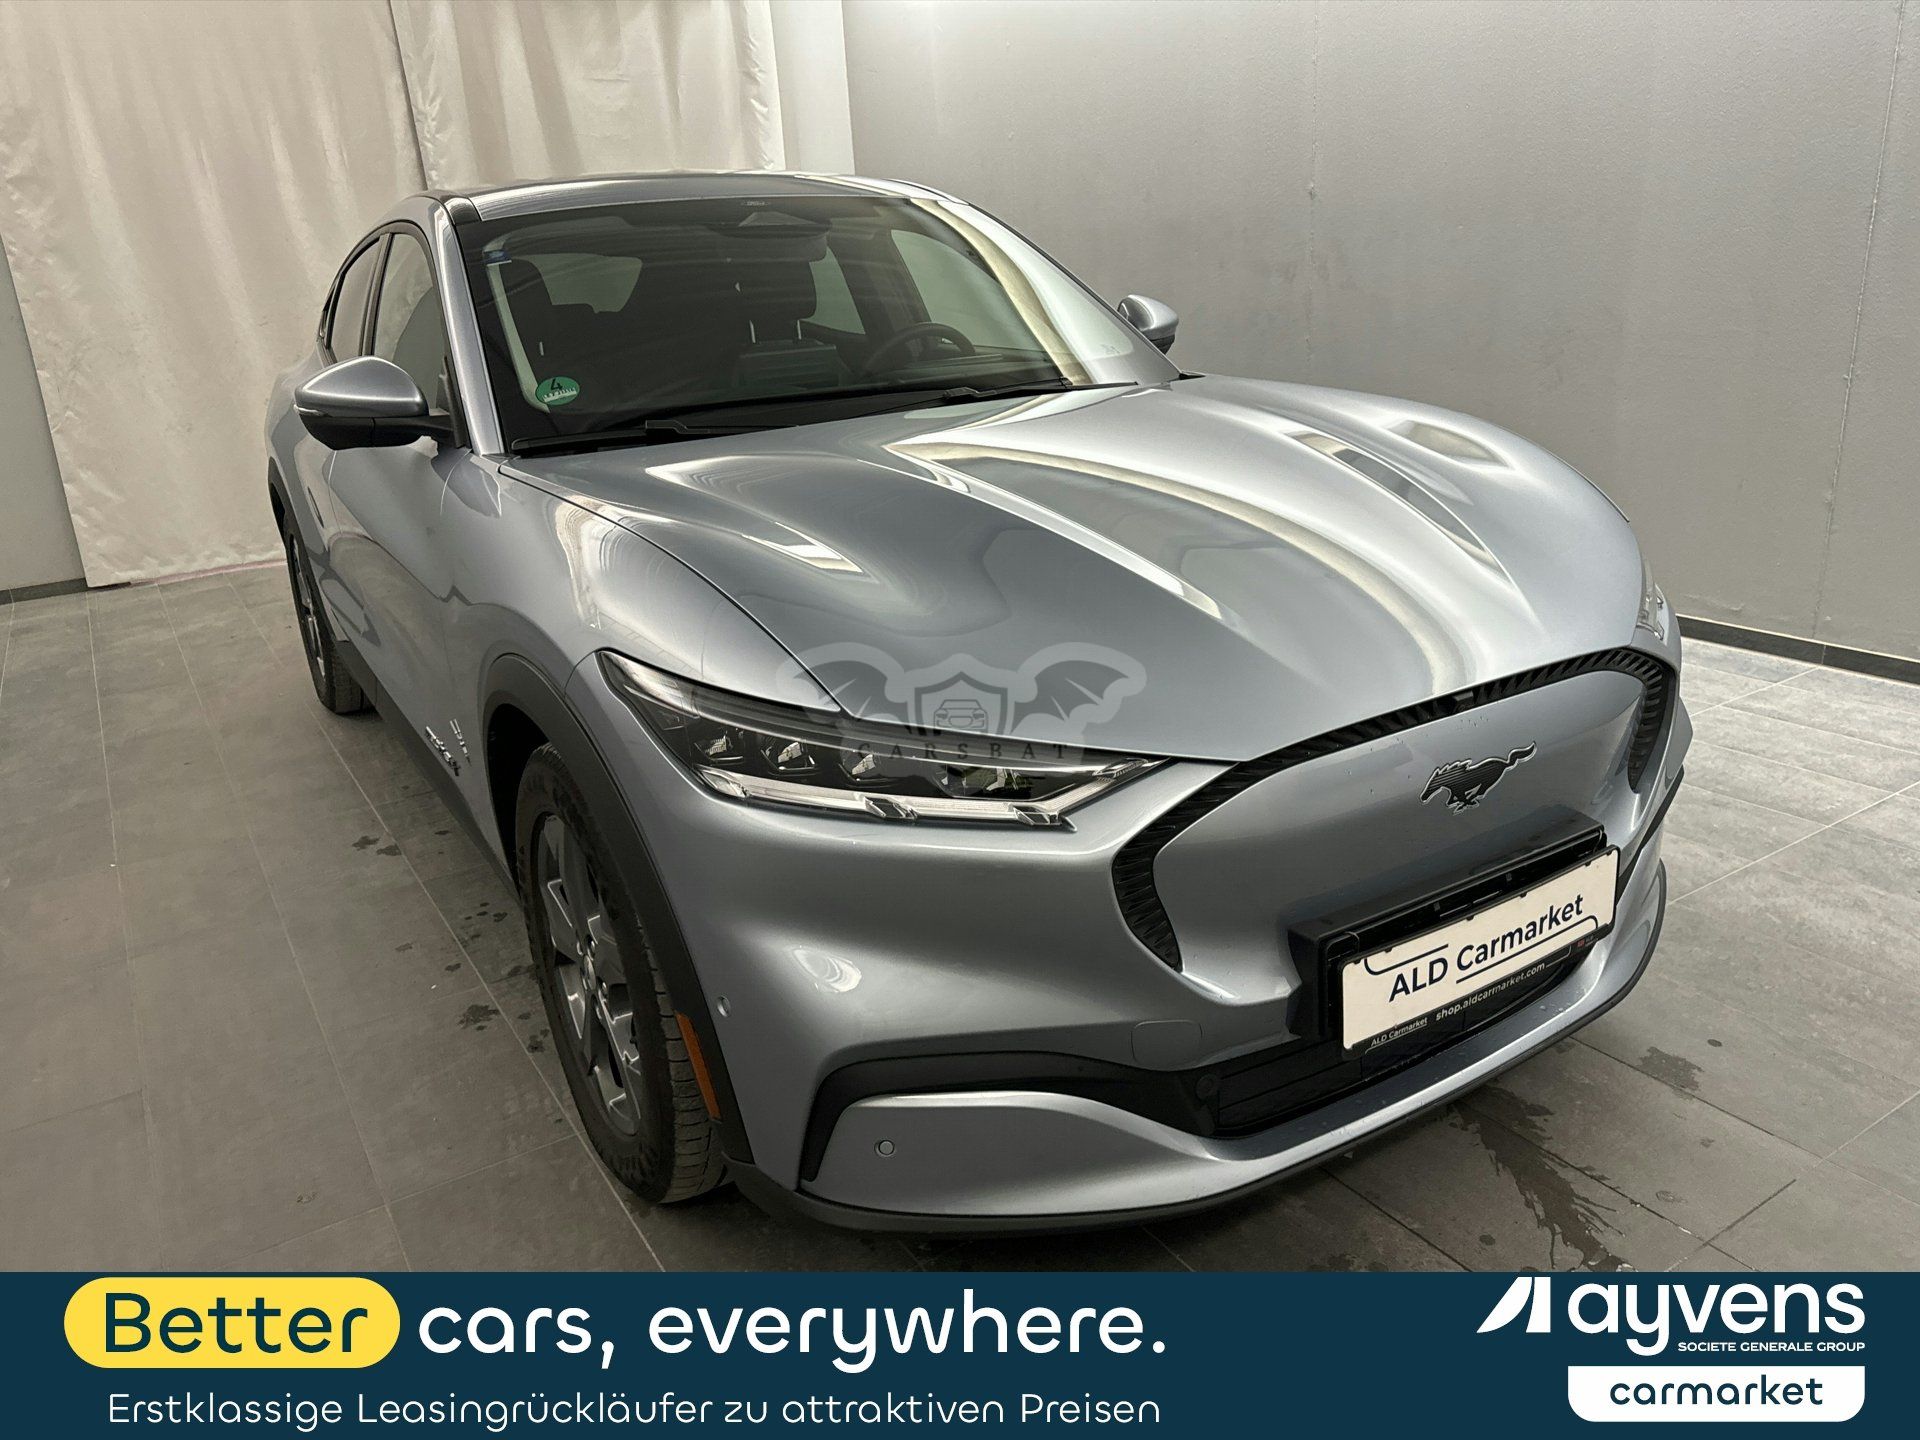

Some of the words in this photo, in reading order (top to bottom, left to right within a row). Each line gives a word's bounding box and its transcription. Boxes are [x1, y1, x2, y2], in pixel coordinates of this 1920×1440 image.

[550, 378, 563, 391] 4
[1388, 956, 1449, 1003] ALD
[1456, 894, 1584, 972] Carmarket
[1436, 962, 1546, 1021] shop.aldcarmarket.com
[1370, 1034, 1388, 1047] ALD
[1388, 1017, 1428, 1039] Carmarket
